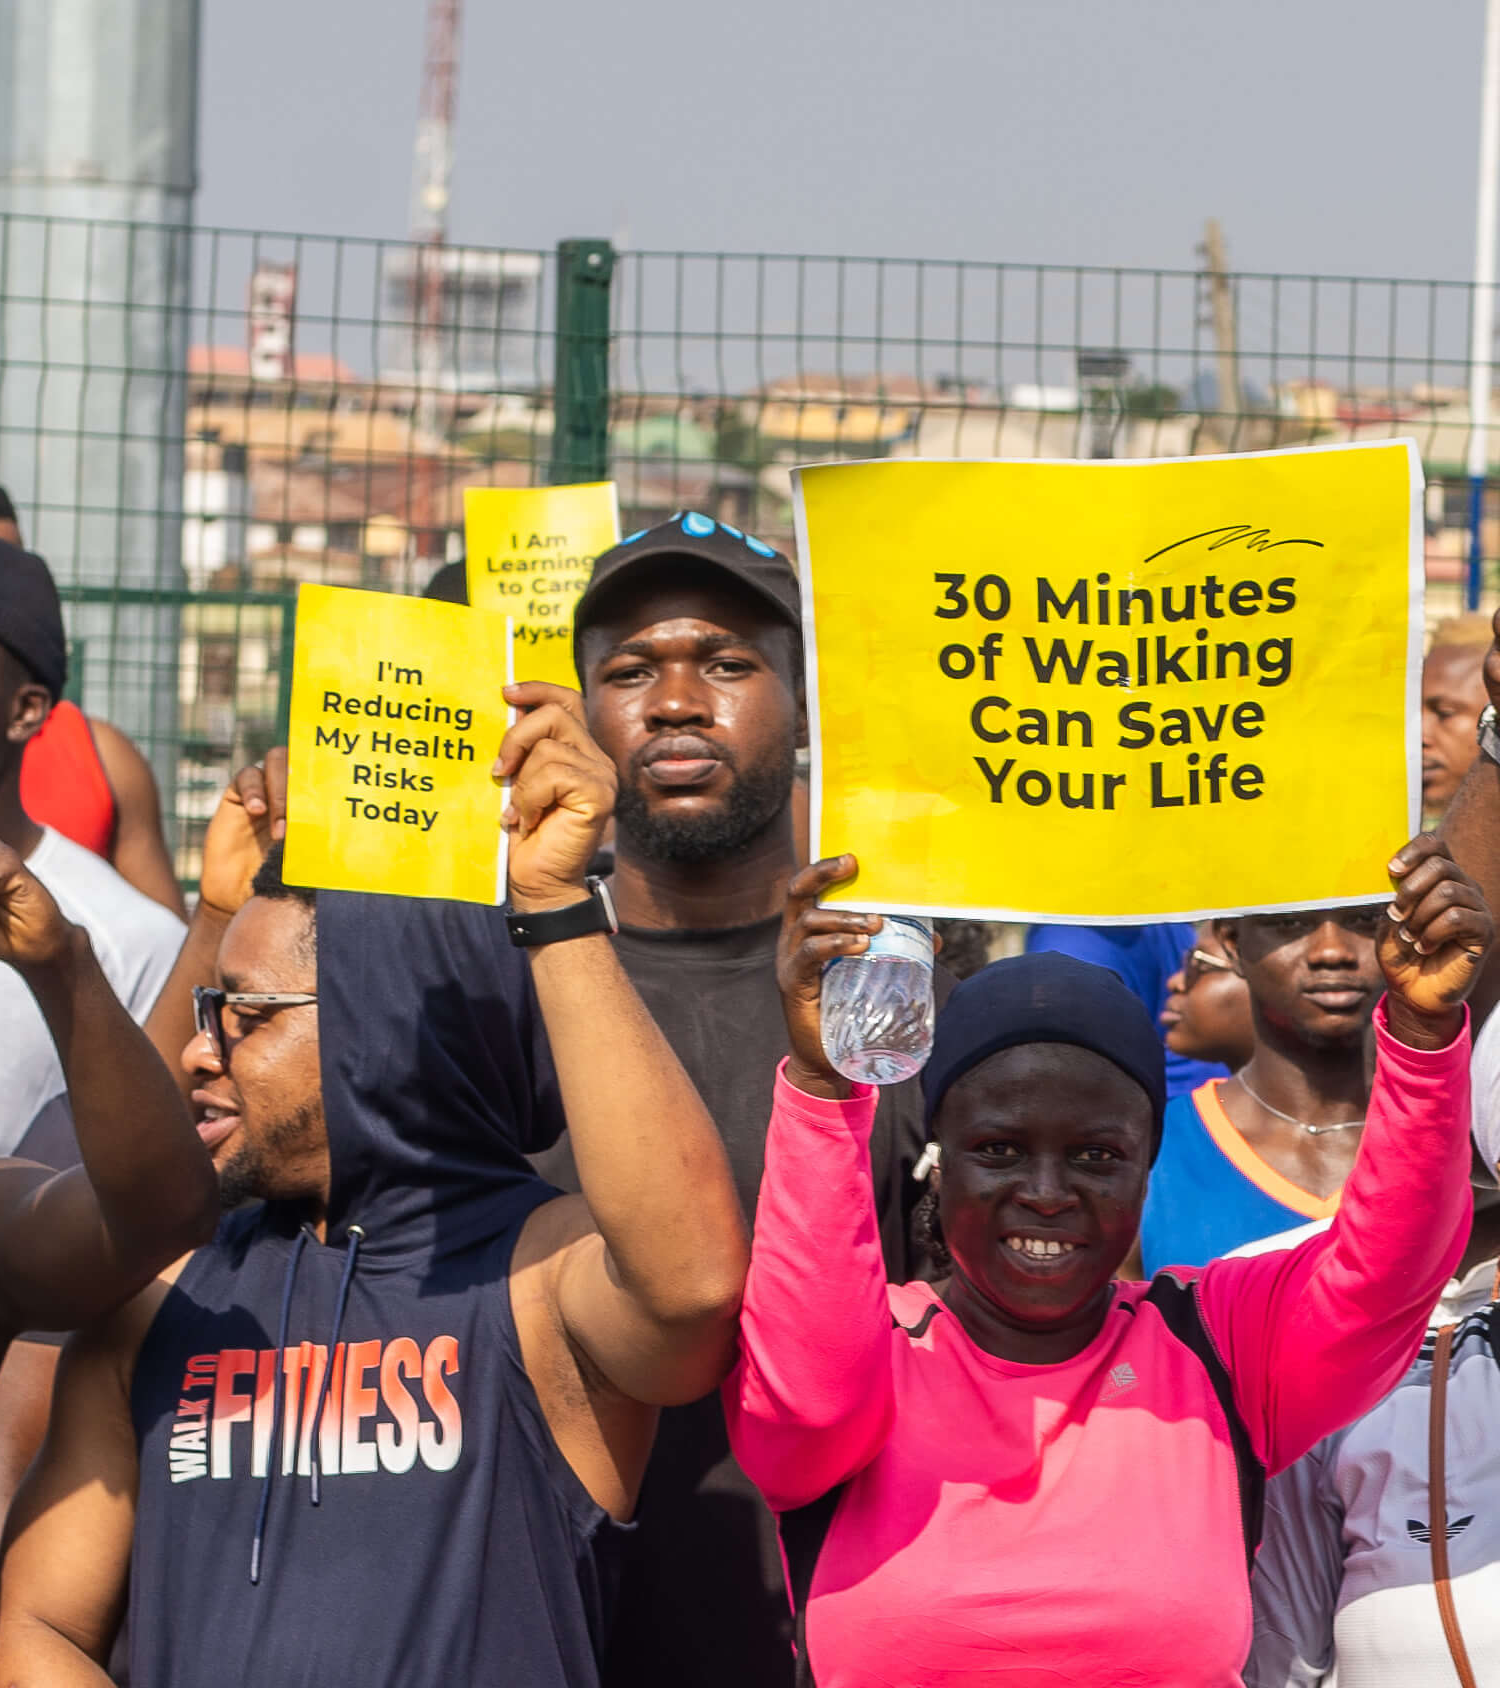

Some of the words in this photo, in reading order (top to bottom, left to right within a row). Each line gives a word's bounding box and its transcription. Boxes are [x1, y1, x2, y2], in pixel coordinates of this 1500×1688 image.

[512, 533, 517, 549] I
[527, 533, 568, 549] Am
[487, 552, 596, 574] Learning
[498, 581, 523, 595] to
[933, 572, 1011, 622] 30
[1036, 571, 1298, 626] Minutes
[527, 600, 561, 617] for
[376, 660, 423, 686] I'm
[938, 632, 1004, 681] of
[1022, 627, 1293, 688] Walking
[323, 690, 473, 732] Reducing
[969, 695, 1094, 748] Can
[1117, 700, 1266, 749] Save
[315, 725, 360, 755] My
[371, 731, 475, 762] Health
[353, 763, 435, 793] Risks
[973, 755, 1126, 811] Your
[1150, 752, 1266, 808] Life
[345, 796, 439, 832] Today
[183, 1355, 219, 1393] TO
[210, 1335, 463, 1479] FITNESS
[170, 1390, 209, 1484] WALK
